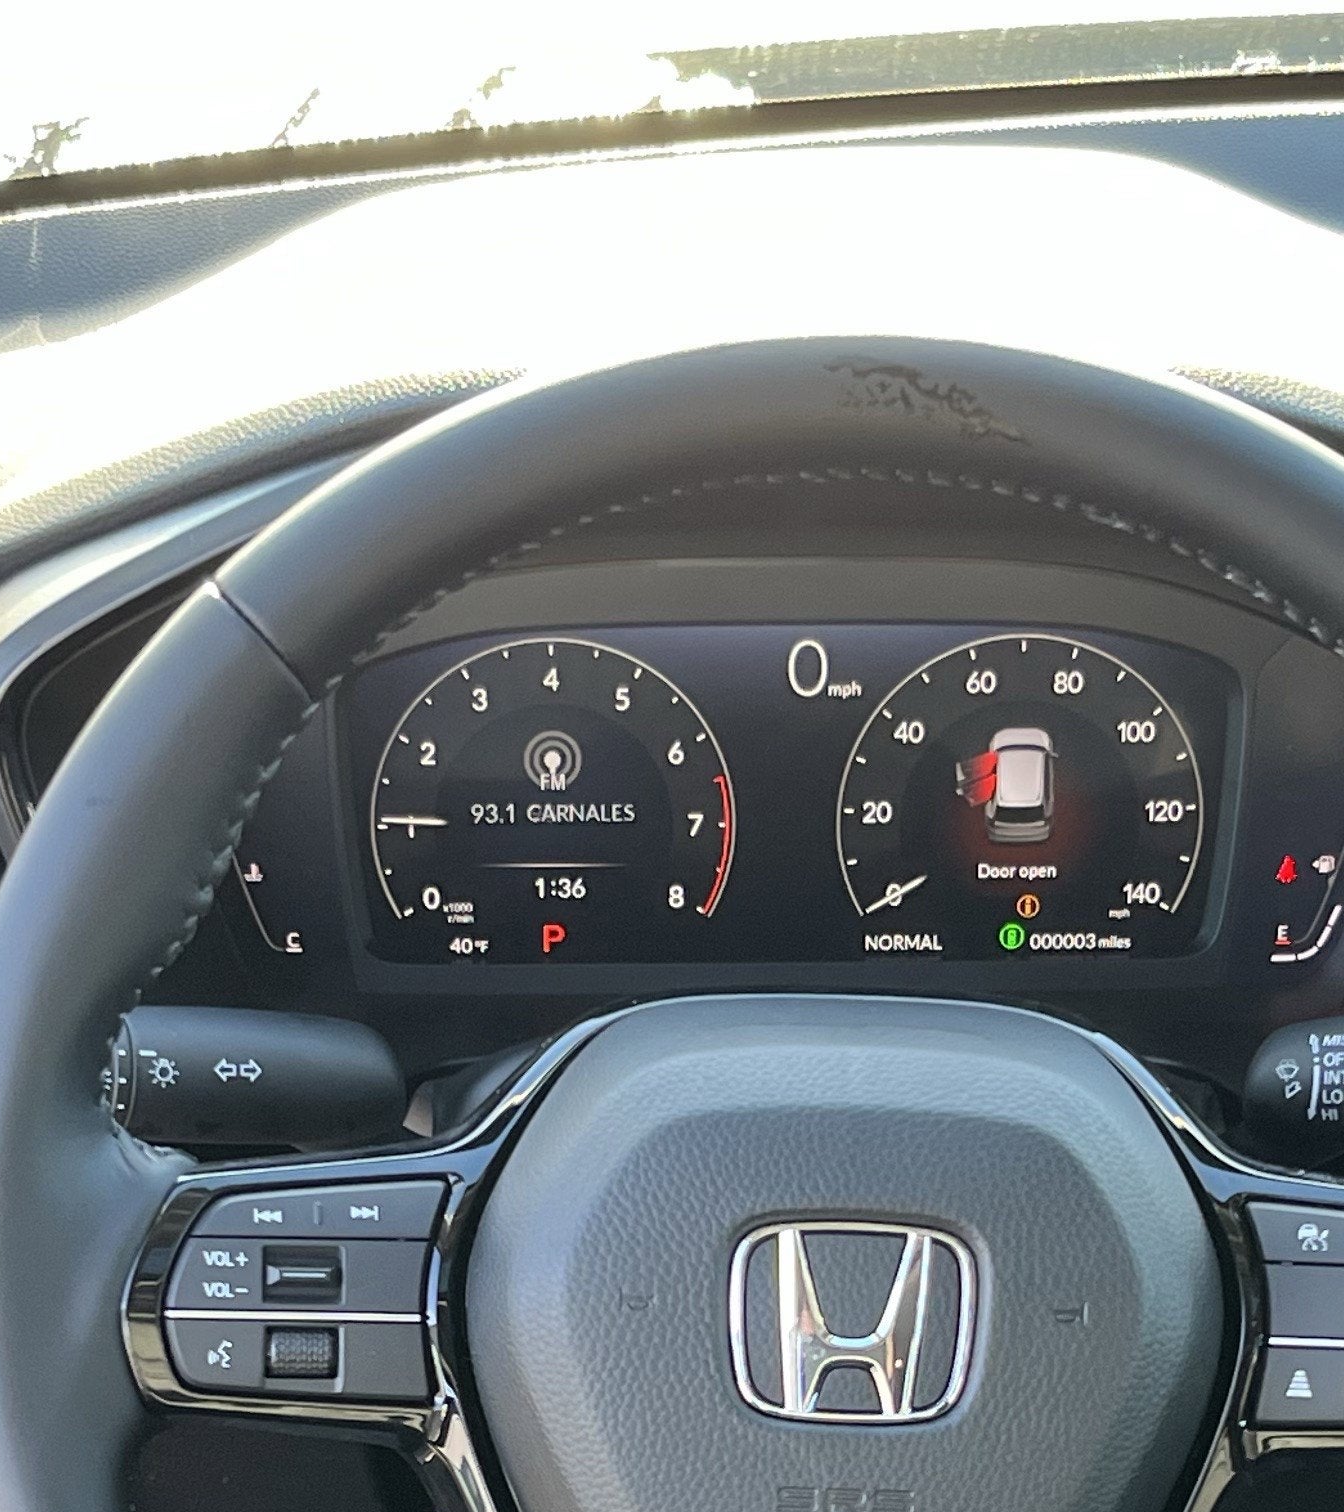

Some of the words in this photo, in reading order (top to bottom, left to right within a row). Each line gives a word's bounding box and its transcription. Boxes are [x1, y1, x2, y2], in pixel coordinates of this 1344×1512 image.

[542, 668, 561, 692] 4
[788, 639, 827, 698] 0
[827, 681, 862, 699] mph
[966, 671, 997, 695] 60
[1052, 671, 1084, 695] 80
[471, 688, 489, 712] 3
[614, 688, 632, 712] 5
[893, 721, 925, 745] 40
[1117, 721, 1155, 745] 100
[419, 742, 437, 766] 2
[667, 741, 685, 765] 6
[540, 774, 566, 791] FM
[470, 803, 516, 825] 93.1
[526, 803, 636, 824] CARNALES
[862, 802, 893, 825] 20
[1145, 801, 1183, 824] 120
[687, 813, 704, 837] 7
[977, 863, 1016, 879] Door
[1019, 865, 1057, 883] open
[422, 887, 441, 911] 0
[534, 878, 587, 900] 1:36
[667, 885, 685, 909] 8
[1122, 882, 1162, 906] 140
[542, 924, 567, 954] P
[864, 933, 943, 952] NORMAL
[1029, 932, 1096, 951] 000003
[1097, 935, 1132, 950] miles
[1322, 1089, 1344, 1105] LO
[1321, 1108, 1340, 1122] HI
